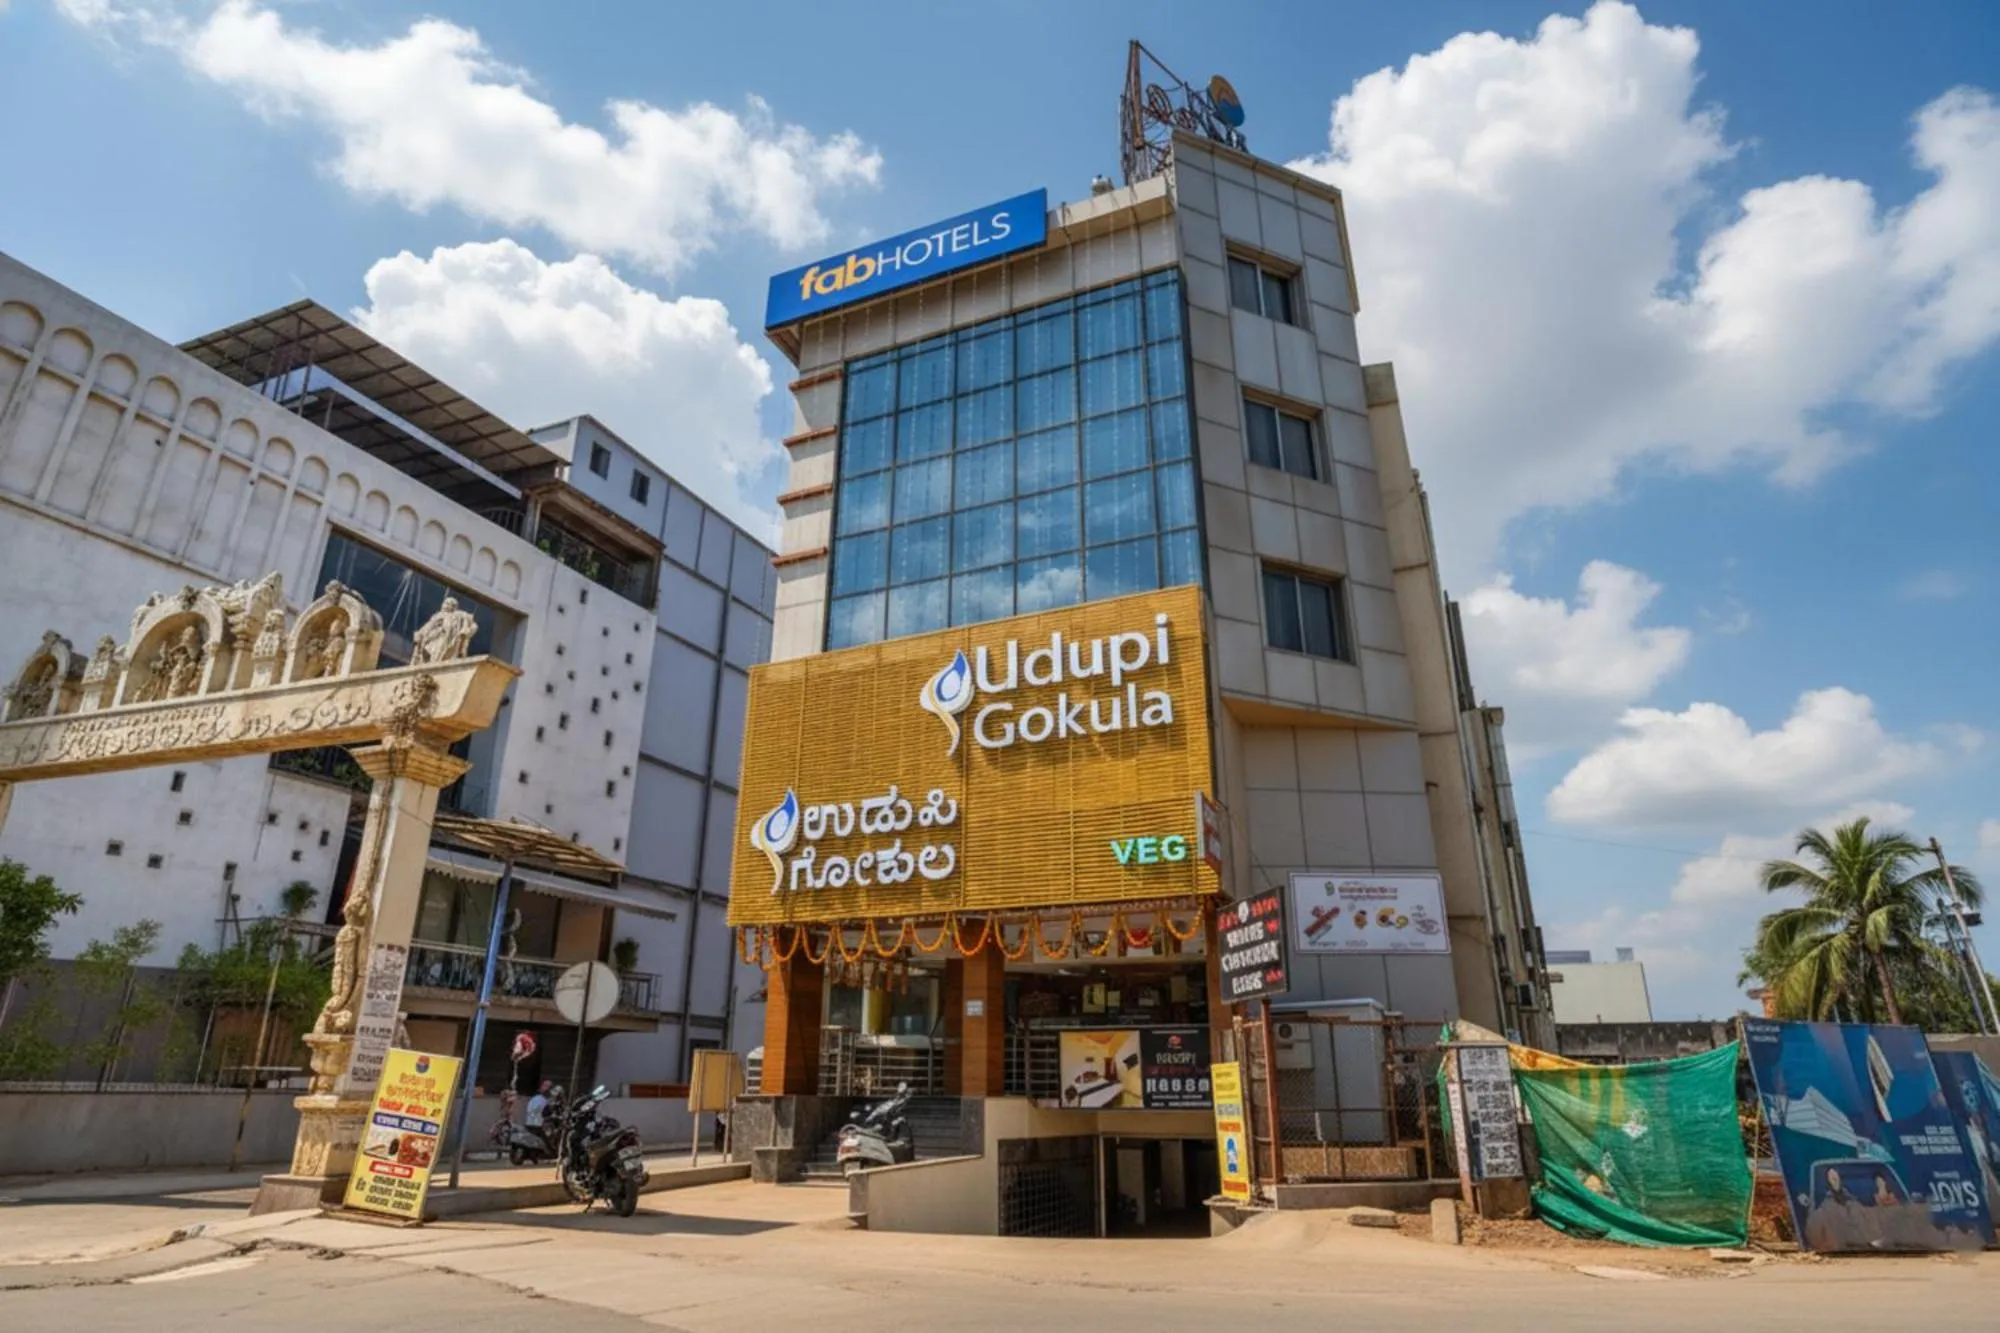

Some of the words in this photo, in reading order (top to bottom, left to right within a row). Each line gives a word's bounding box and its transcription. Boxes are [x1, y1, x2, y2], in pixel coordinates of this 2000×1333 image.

[800, 212, 1011, 300] fabHOTELS
[975, 612, 1169, 693] Udupi
[973, 682, 1174, 748] Gokula
[804, 785, 958, 840] ಉಡುಪಿ
[789, 838, 956, 891] ಗೋಕುಲ
[1110, 835, 1186, 864] VEG
